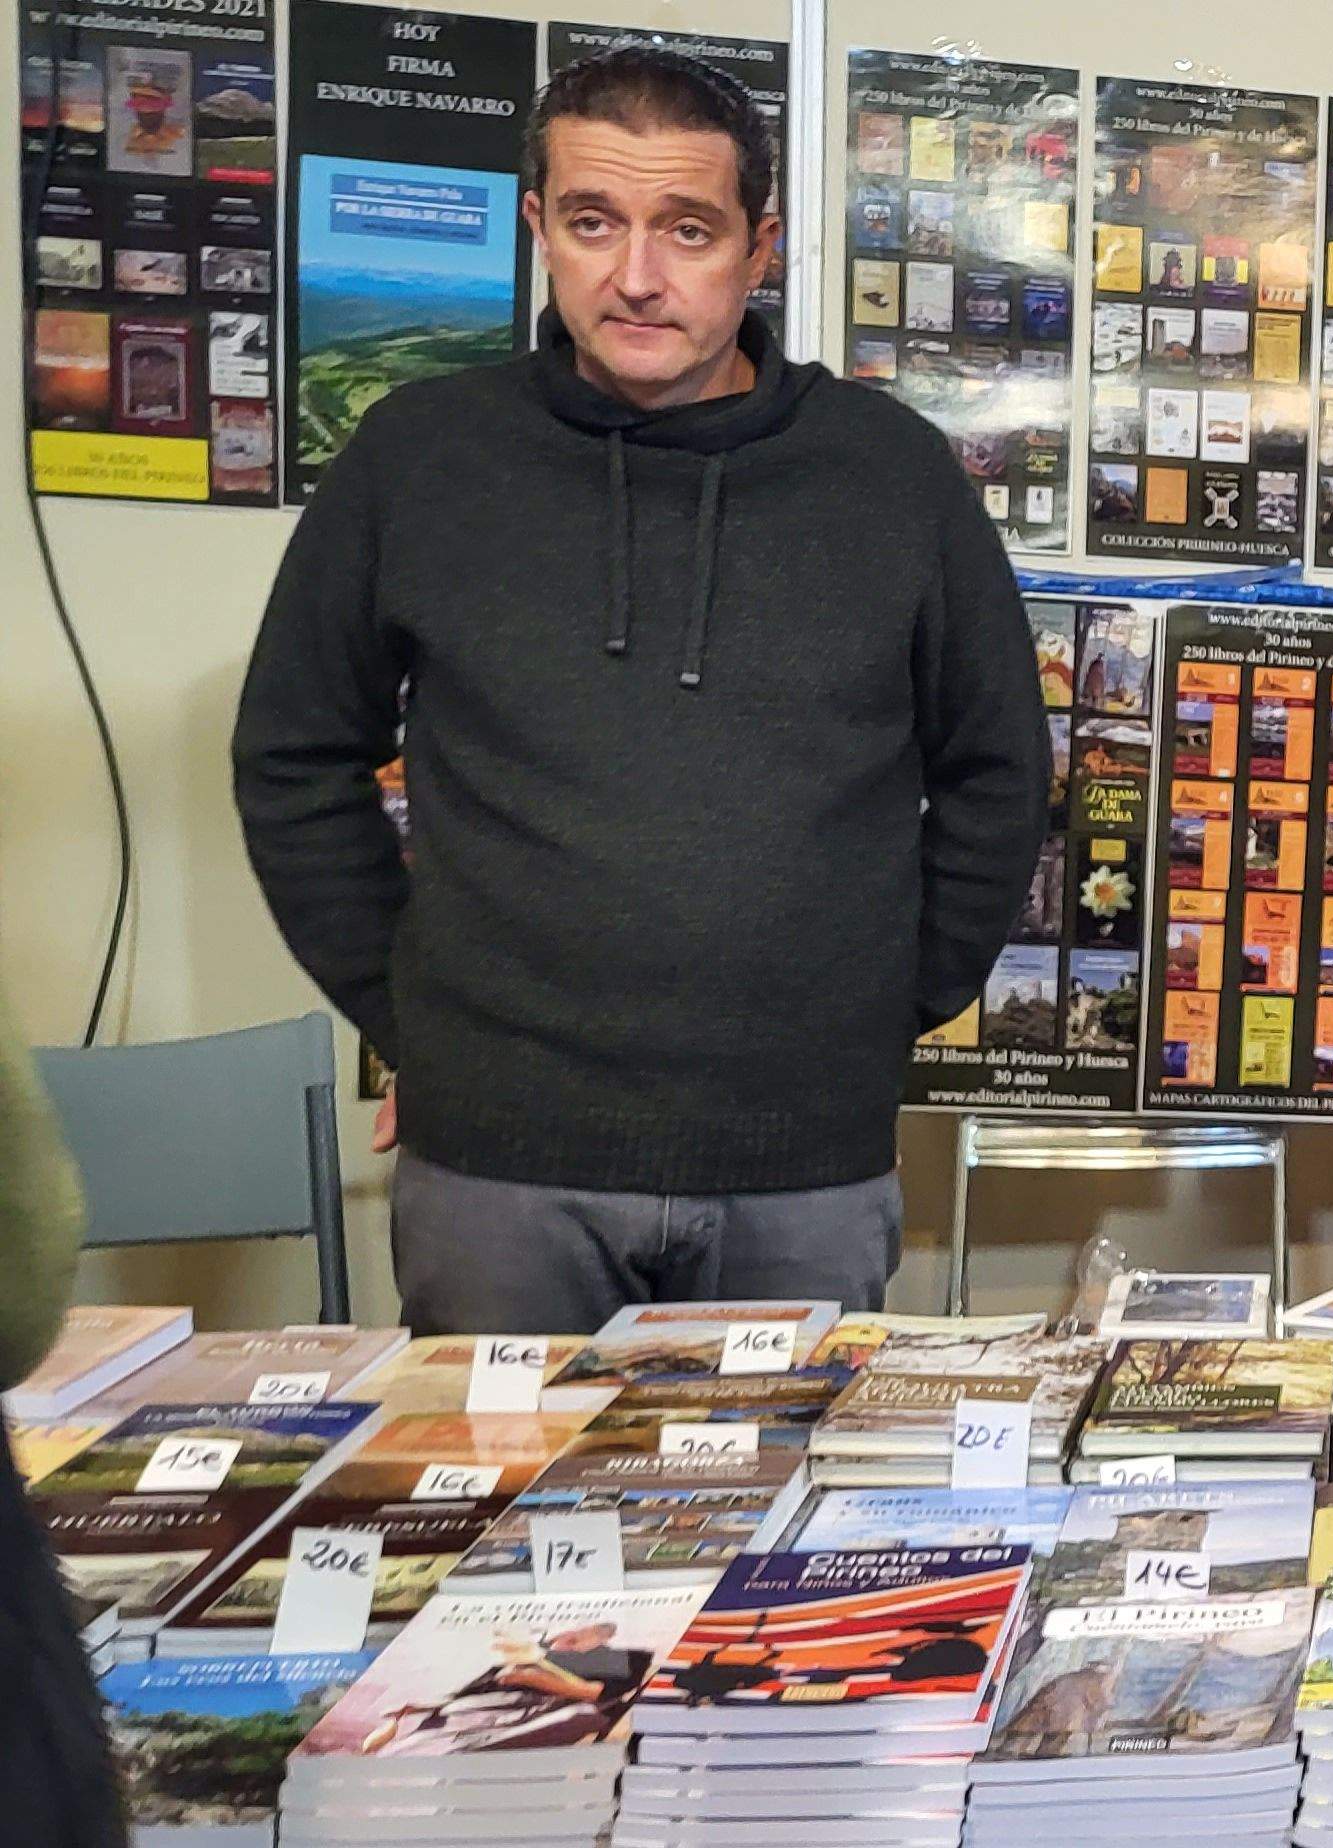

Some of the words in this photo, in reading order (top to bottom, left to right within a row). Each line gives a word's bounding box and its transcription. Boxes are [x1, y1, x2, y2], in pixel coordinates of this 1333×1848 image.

[211, 0, 266, 18] 2021
[394, 22, 442, 42] HOY
[386, 56, 456, 79] FIRMA
[316, 82, 414, 108] ENRIQUE
[415, 91, 517, 117] NAVARRO
[1101, 533, 1175, 550] COLECCIÓN
[1264, 633, 1280, 647] 30
[1282, 635, 1312, 650] años
[1183, 644, 1207, 660] 250
[1209, 645, 1244, 663] libros
[1246, 648, 1266, 664] del
[1268, 650, 1314, 668] Pirineo
[1088, 807, 1133, 823] GUARA
[913, 1048, 940, 1064] 250
[942, 1048, 983, 1066] libros
[986, 1049, 1007, 1067] del
[1009, 1049, 1063, 1069] Pirineo
[1065, 1055, 1075, 1071] y
[1077, 1051, 1129, 1070] Huesca
[994, 1070, 1013, 1086] 30
[1015, 1069, 1049, 1087] años
[927, 1086, 1111, 1110] www.editorialpirineo.com
[1149, 1091, 1191, 1107] MAPAS
[1297, 1096, 1320, 1111] DEL
[731, 1328, 791, 1352] 16€
[487, 1340, 548, 1369] 16€
[155, 1442, 225, 1473] 15€
[301, 1537, 371, 1579] 20€
[806, 1549, 949, 1568] Cuentos
[961, 1546, 1013, 1563] del
[801, 1563, 923, 1580] Pirineo
[1133, 1558, 1208, 1590] 14€
[1083, 1609, 1117, 1623] El
[1135, 1606, 1264, 1622] Pirineo
